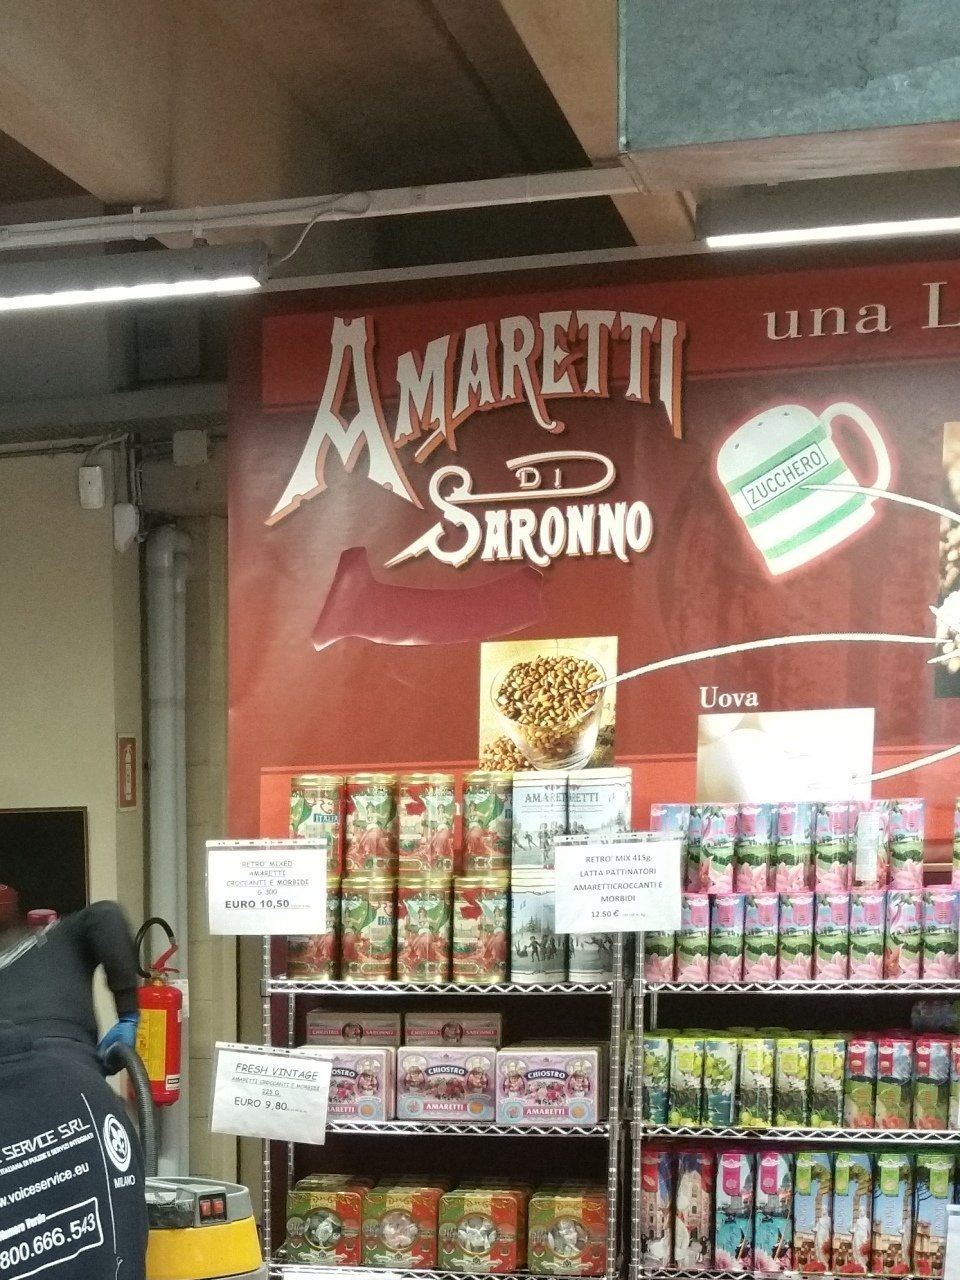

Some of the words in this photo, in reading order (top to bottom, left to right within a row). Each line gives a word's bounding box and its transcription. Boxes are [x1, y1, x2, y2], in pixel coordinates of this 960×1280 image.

[763, 304, 892, 340] una
[266, 309, 685, 526] AMARETTI
[514, 467, 562, 489] DI
[747, 450, 823, 505] ZUCCHERO
[384, 465, 653, 568] SARONNO
[699, 686, 759, 708] Uova
[580, 869, 604, 877] LATTA
[606, 867, 657, 876] PATTINATORI
[225, 900, 256, 909] EURO
[259, 899, 290, 909] 10,50
[600, 895, 636, 903] MORBIDI
[613, 909, 619, 917] €
[235, 1063, 269, 1075] FRESH
[272, 1067, 319, 1081] VINTAGE
[331, 1067, 355, 1078] OSTRO
[428, 1065, 465, 1076] CHIOSTRO
[527, 1070, 566, 1079] CHIOSTRO
[234, 1096, 261, 1108] EURO
[265, 1100, 288, 1111] 9,80
[426, 1103, 464, 1111] AMARETTI
[1, 1129, 58, 1161] SERVICE
[57, 1117, 91, 1139] SRL
[114, 1174, 136, 1189] MILANO
[0, 1213, 96, 1270] 800.666.543
